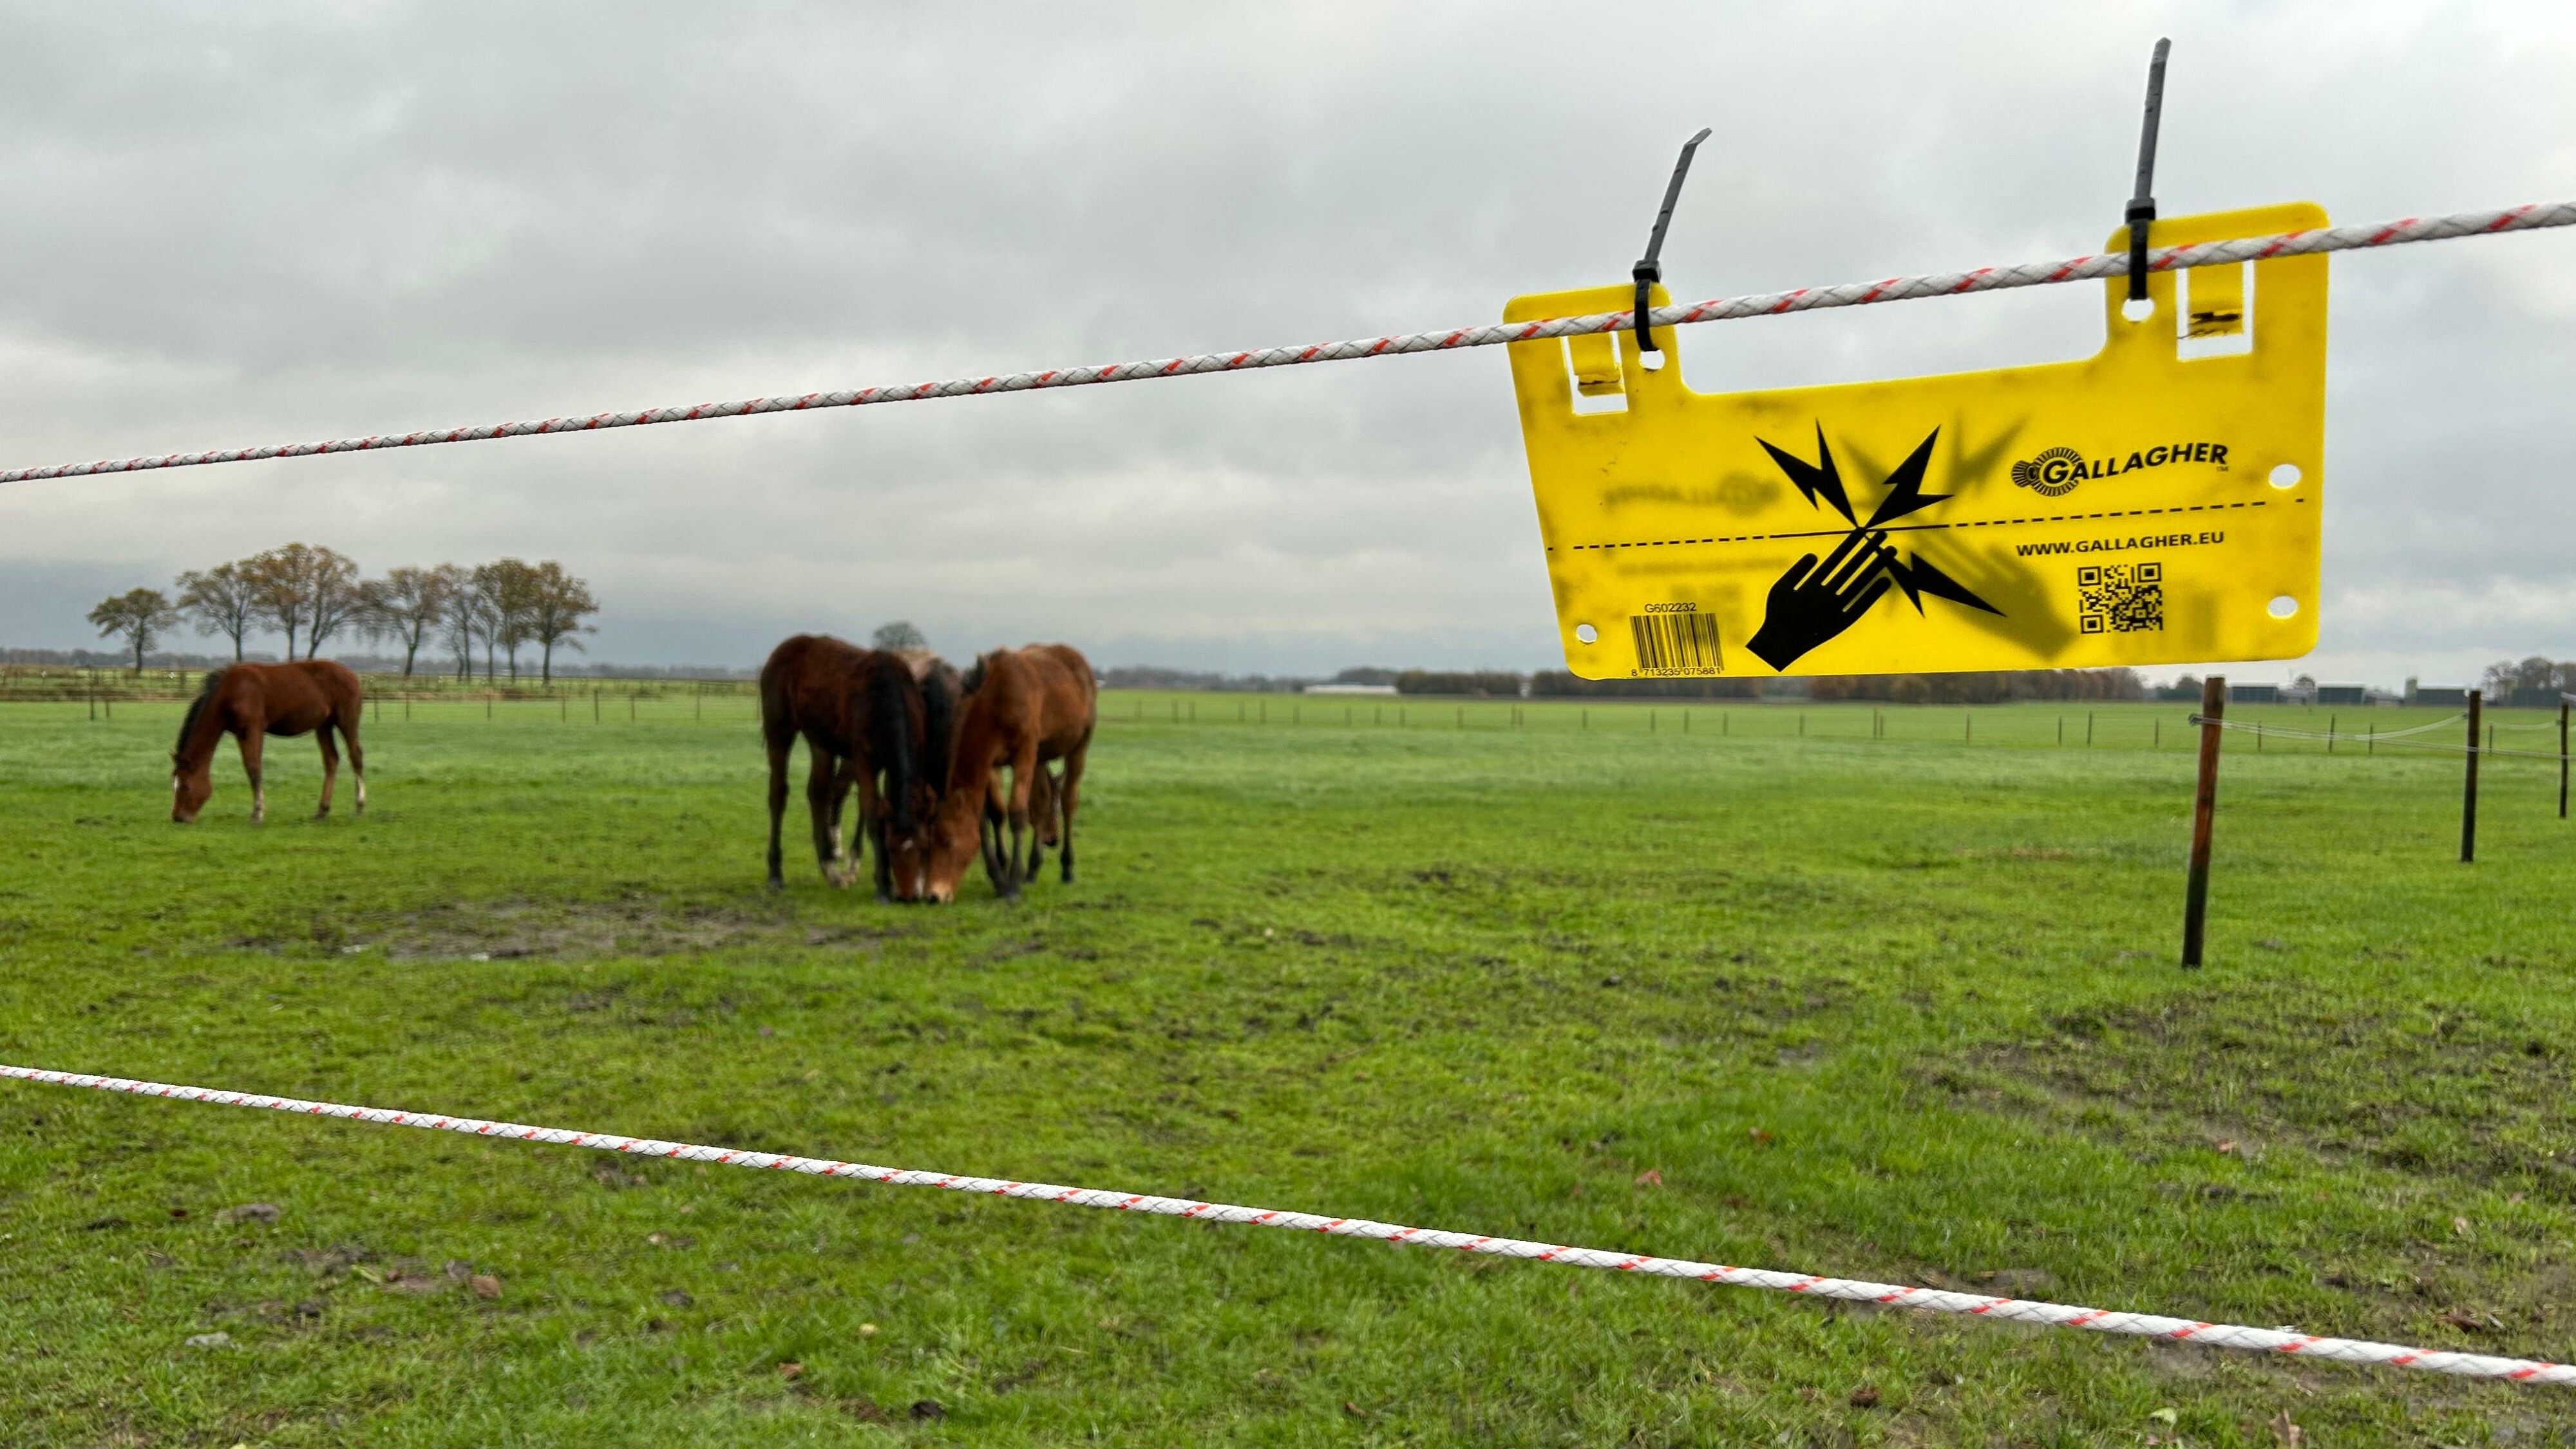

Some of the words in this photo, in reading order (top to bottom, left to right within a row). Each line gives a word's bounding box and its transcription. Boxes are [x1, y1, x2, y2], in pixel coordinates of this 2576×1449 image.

[2042, 442, 2229, 484] GALLAGHER
[2016, 531, 2224, 556] WWW.GALLAGHER.EU
[1644, 602, 1697, 613] G602232
[1643, 667, 1681, 676] 713235
[1683, 667, 1721, 676] 075881
